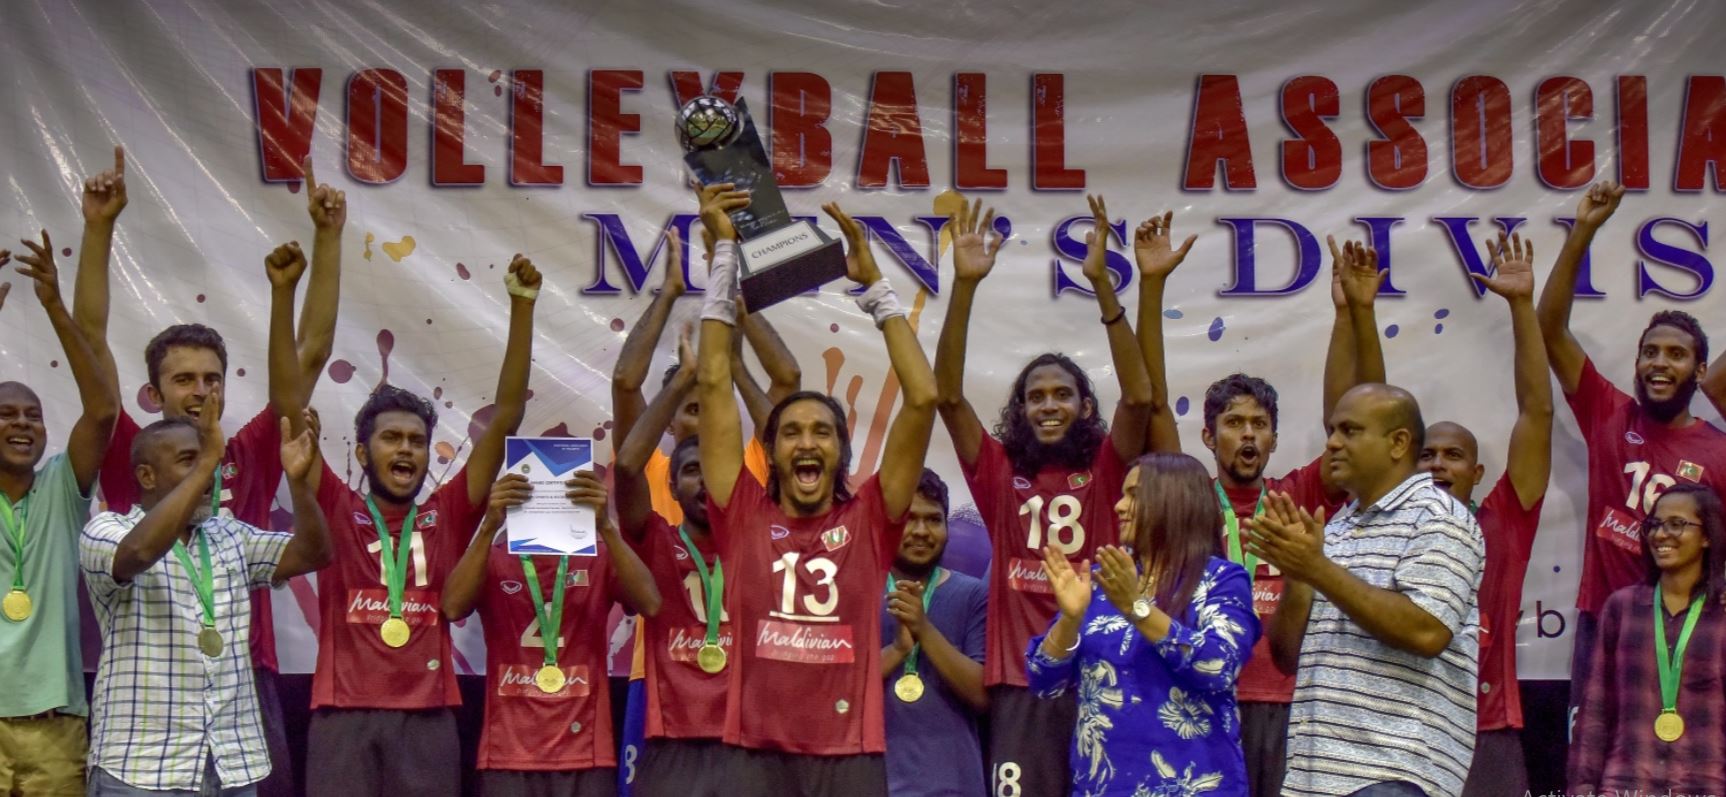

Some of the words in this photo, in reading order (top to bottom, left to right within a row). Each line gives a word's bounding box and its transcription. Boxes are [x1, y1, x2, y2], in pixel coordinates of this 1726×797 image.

[1183, 73, 1726, 192] ASSOCIA
[583, 212, 1134, 298] MN'S
[751, 232, 819, 259] CHAMPIONS
[1018, 494, 1086, 555] 18
[772, 551, 840, 617] 13
[756, 621, 853, 650] Maldivian
